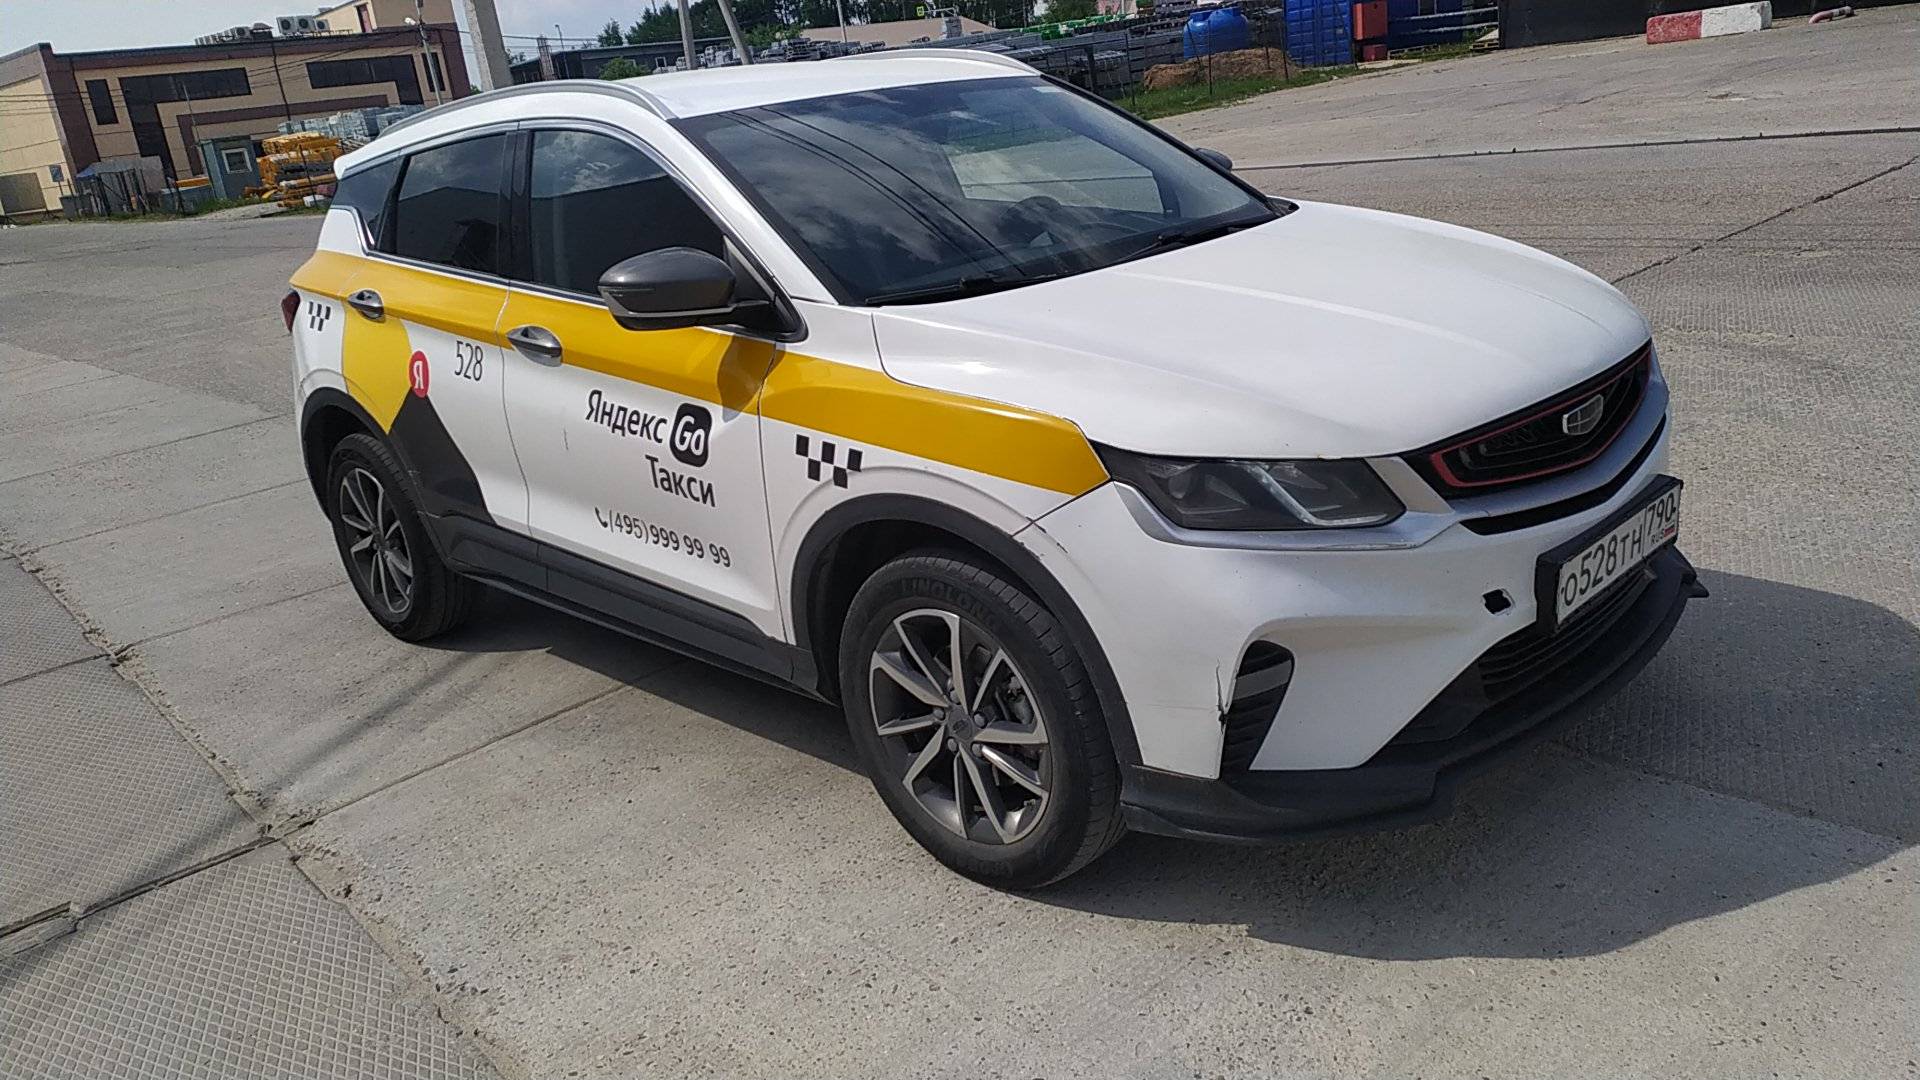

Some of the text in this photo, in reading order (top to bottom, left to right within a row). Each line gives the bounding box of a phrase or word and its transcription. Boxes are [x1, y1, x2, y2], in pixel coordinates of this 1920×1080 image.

[413, 360, 425, 389] Я
[454, 340, 483, 381] 528
[585, 389, 706, 456] Яндекс Go
[645, 454, 715, 507] Такси
[1647, 492, 1674, 536] 790
[684, 535, 704, 559] 99
[709, 543, 731, 568] 99
